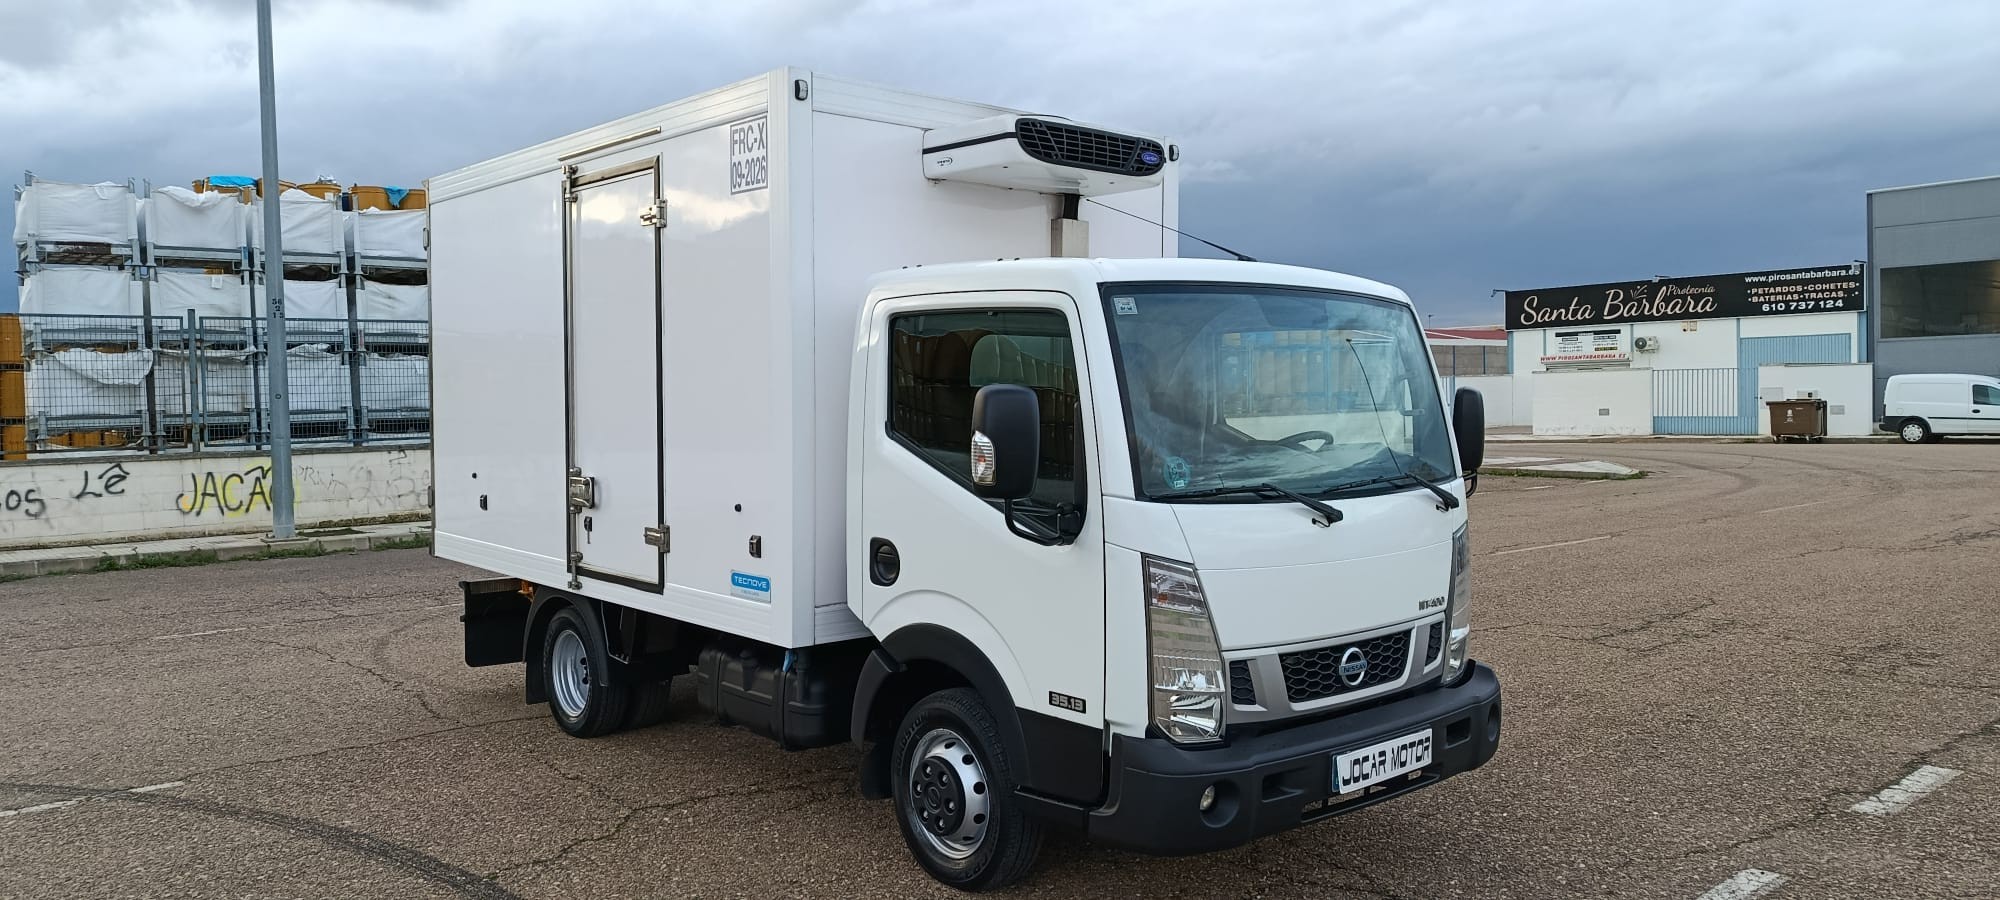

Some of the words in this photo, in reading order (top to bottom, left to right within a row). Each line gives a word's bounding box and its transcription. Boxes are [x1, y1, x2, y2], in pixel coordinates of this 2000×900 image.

[732, 121, 765, 157] FRC-X
[732, 155, 766, 189] 09-2026
[1666, 284, 1716, 297] Pirotecnia
[1520, 295, 1596, 326] Santa
[1602, 286, 1719, 320] Barbara
[1761, 302, 1786, 312] 610
[1789, 300, 1815, 310] 737
[1818, 299, 1844, 309] 124
[176, 465, 273, 517] JACÃ
[735, 575, 767, 589] TECNOVE
[1343, 662, 1367, 674] NISSAN
[1051, 693, 1084, 712] 35.13
[1342, 750, 1387, 787] JOCAR
[1391, 735, 1431, 772] MOTOR
